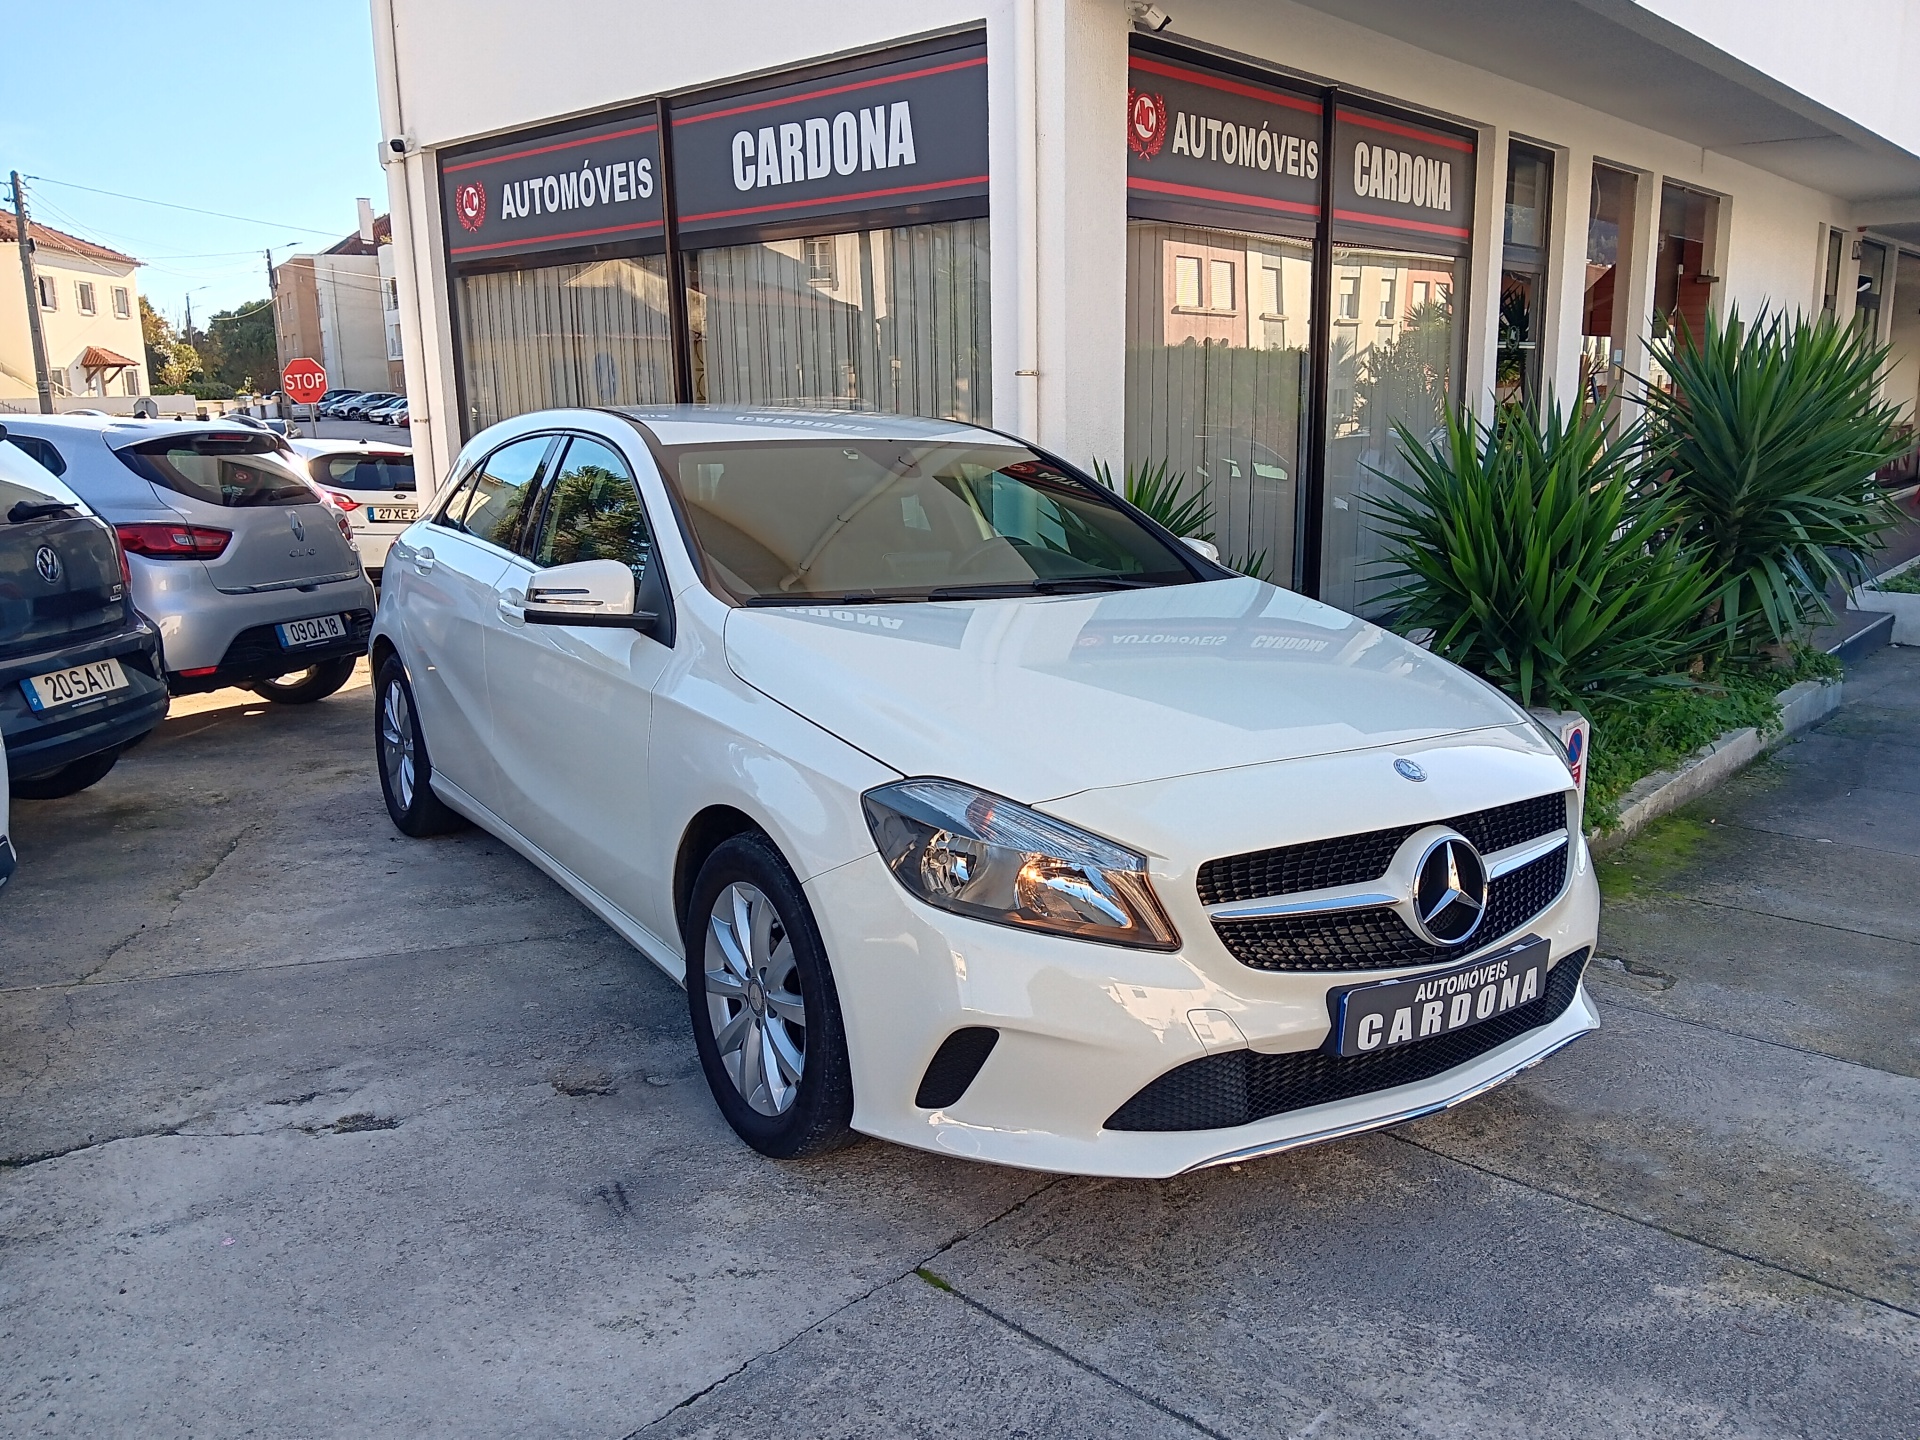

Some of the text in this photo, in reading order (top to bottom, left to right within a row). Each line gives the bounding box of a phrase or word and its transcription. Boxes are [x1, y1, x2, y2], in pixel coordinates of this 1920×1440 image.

[501, 100, 917, 220] AUTOMÓVEIS CARDONA
[1172, 111, 1452, 211] AUTOMÓVEIS CARDONA
[284, 372, 325, 390] STOP
[289, 547, 316, 558] CLIO
[1357, 966, 1539, 1051] CARDONA
[1414, 960, 1509, 1003] AUTOMÓVEIS
